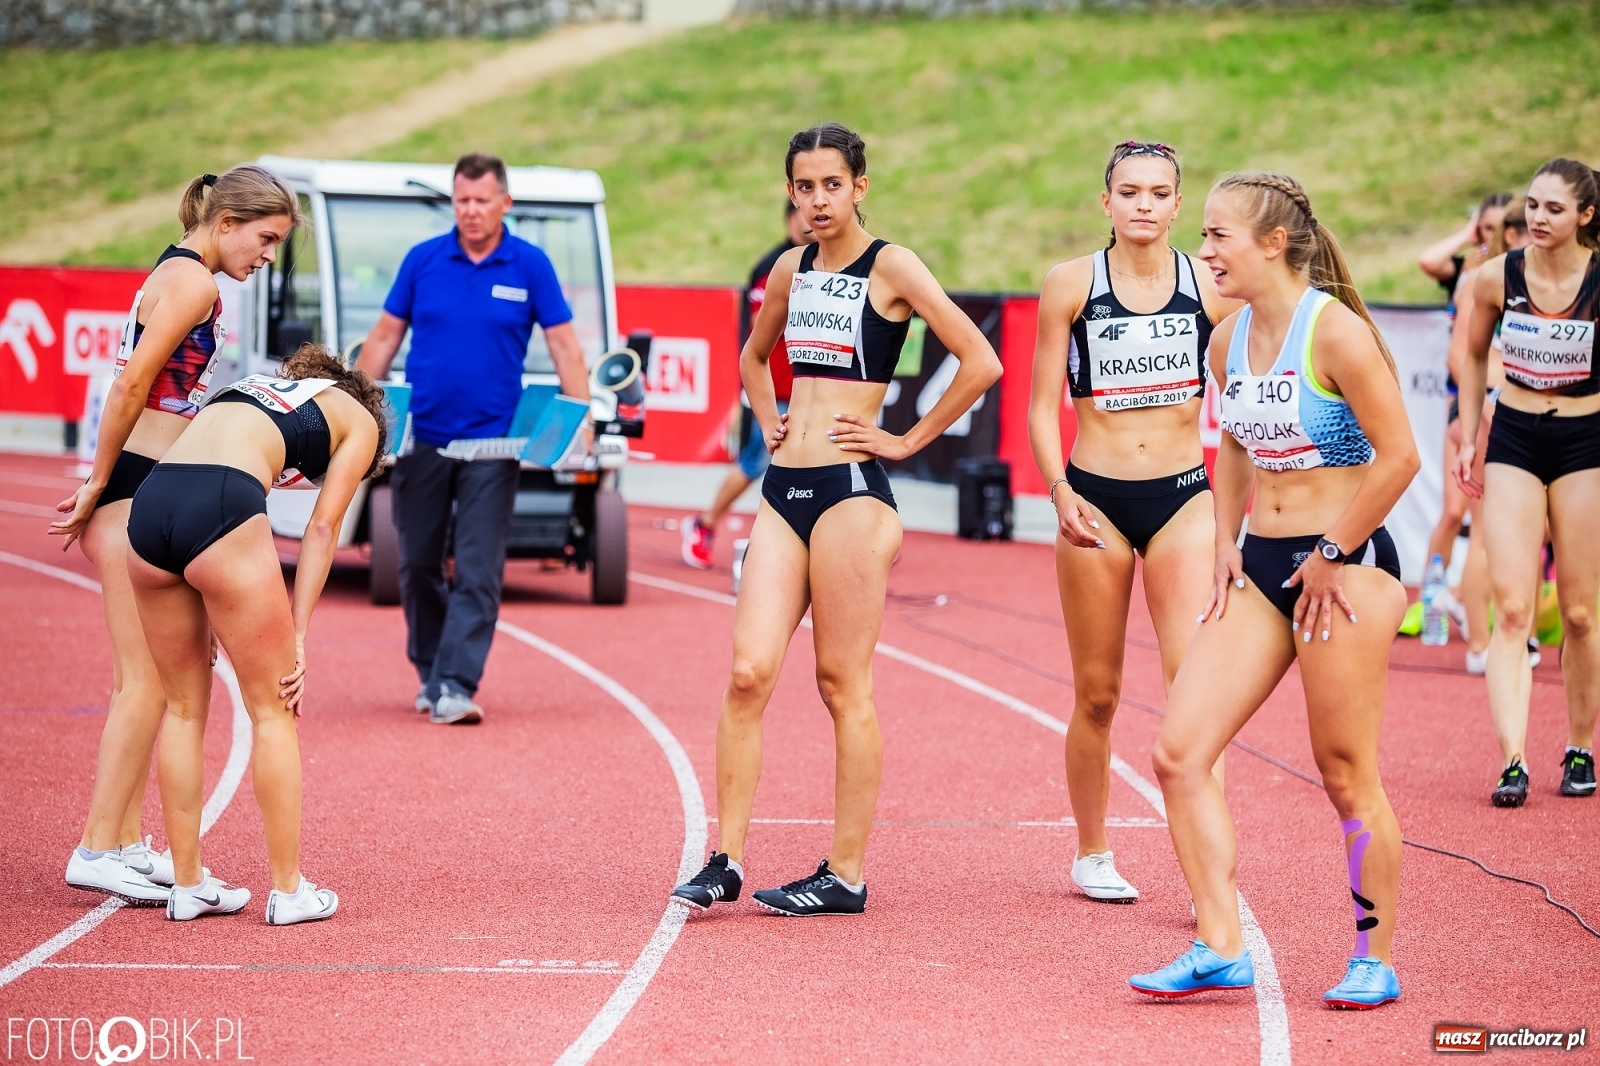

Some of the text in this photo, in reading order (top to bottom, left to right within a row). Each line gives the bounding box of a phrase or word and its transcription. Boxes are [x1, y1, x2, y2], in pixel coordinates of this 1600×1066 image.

[820, 277, 863, 300] 423
[788, 310, 852, 333] ALINOWSKA
[1098, 317, 1193, 341] 4F 152
[1550, 323, 1589, 342] 297
[812, 351, 838, 362] 2019
[1504, 342, 1588, 365] SKIERKOWSKA
[1099, 352, 1191, 376] KRASICKA
[251, 390, 276, 407] 2019
[1106, 391, 1188, 409] RACIBÓRZ 2019
[1257, 380, 1293, 403] 140
[1279, 457, 1304, 471] 2019
[1177, 469, 1206, 488] NIKE
[794, 489, 814, 499] asics
